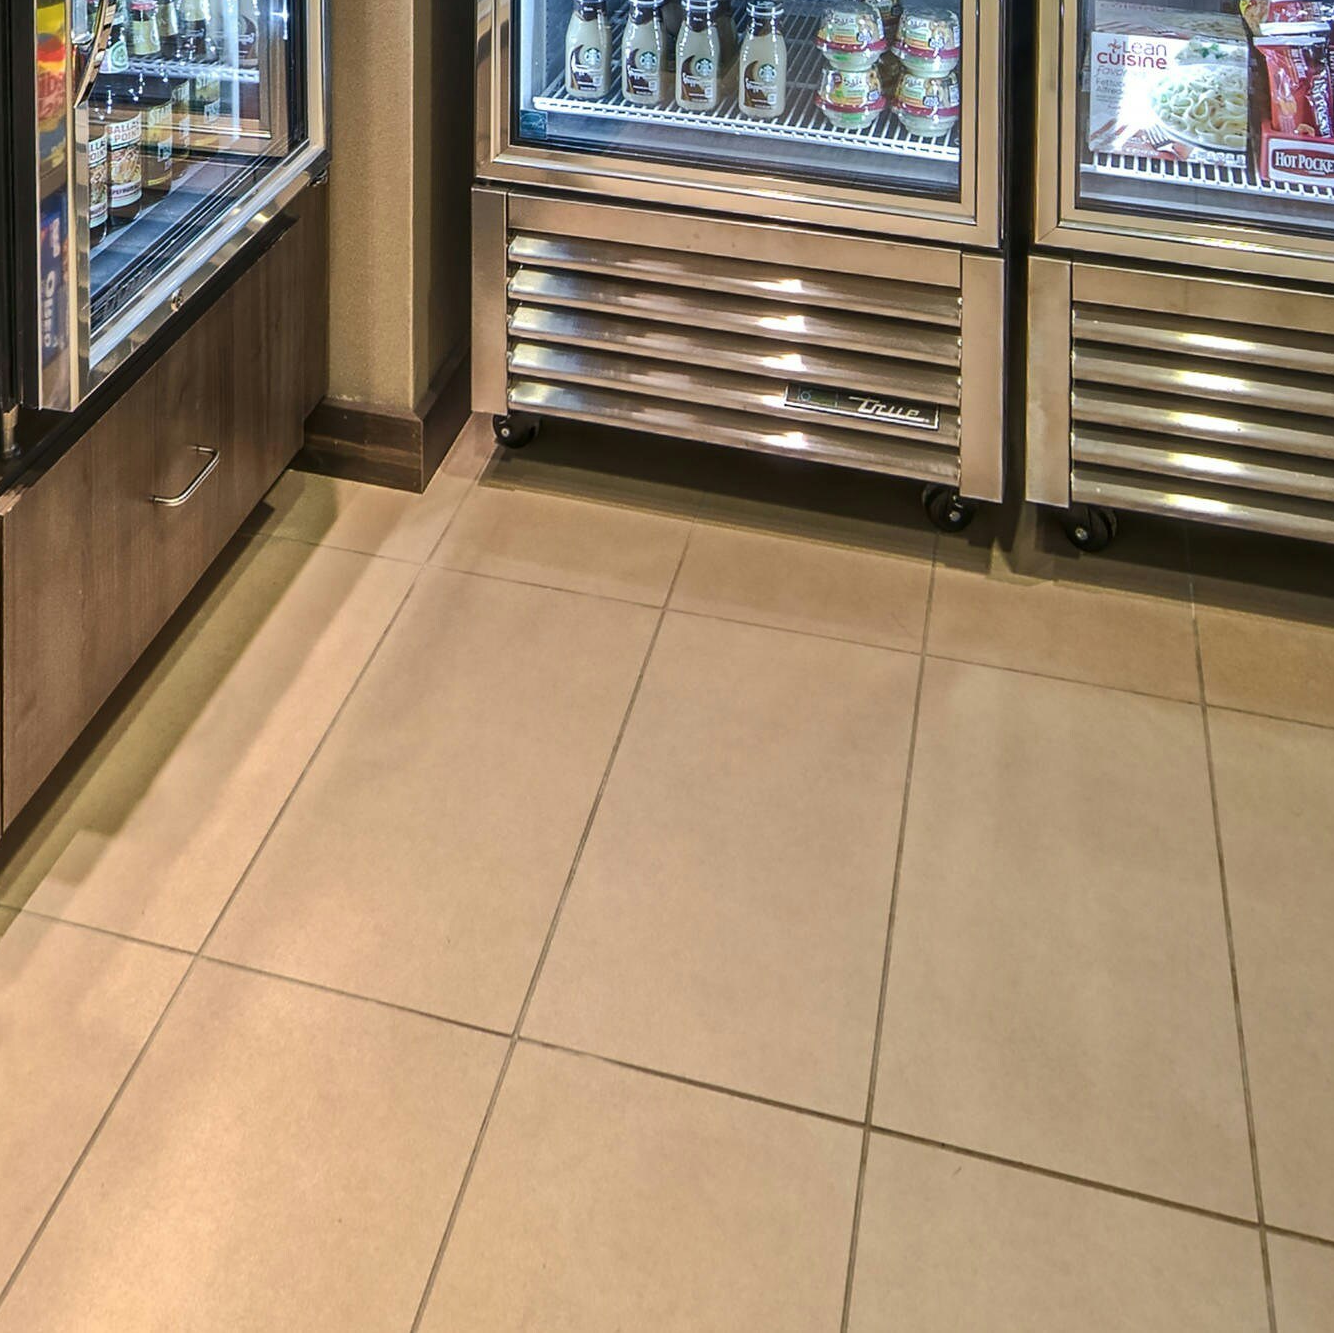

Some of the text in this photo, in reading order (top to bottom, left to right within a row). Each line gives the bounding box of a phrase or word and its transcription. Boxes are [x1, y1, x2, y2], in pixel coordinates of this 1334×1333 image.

[1120, 41, 1167, 56] Lean
[1097, 51, 1167, 70] cuisine
[1275, 151, 1298, 168] HOT
[848, 395, 927, 423] True
